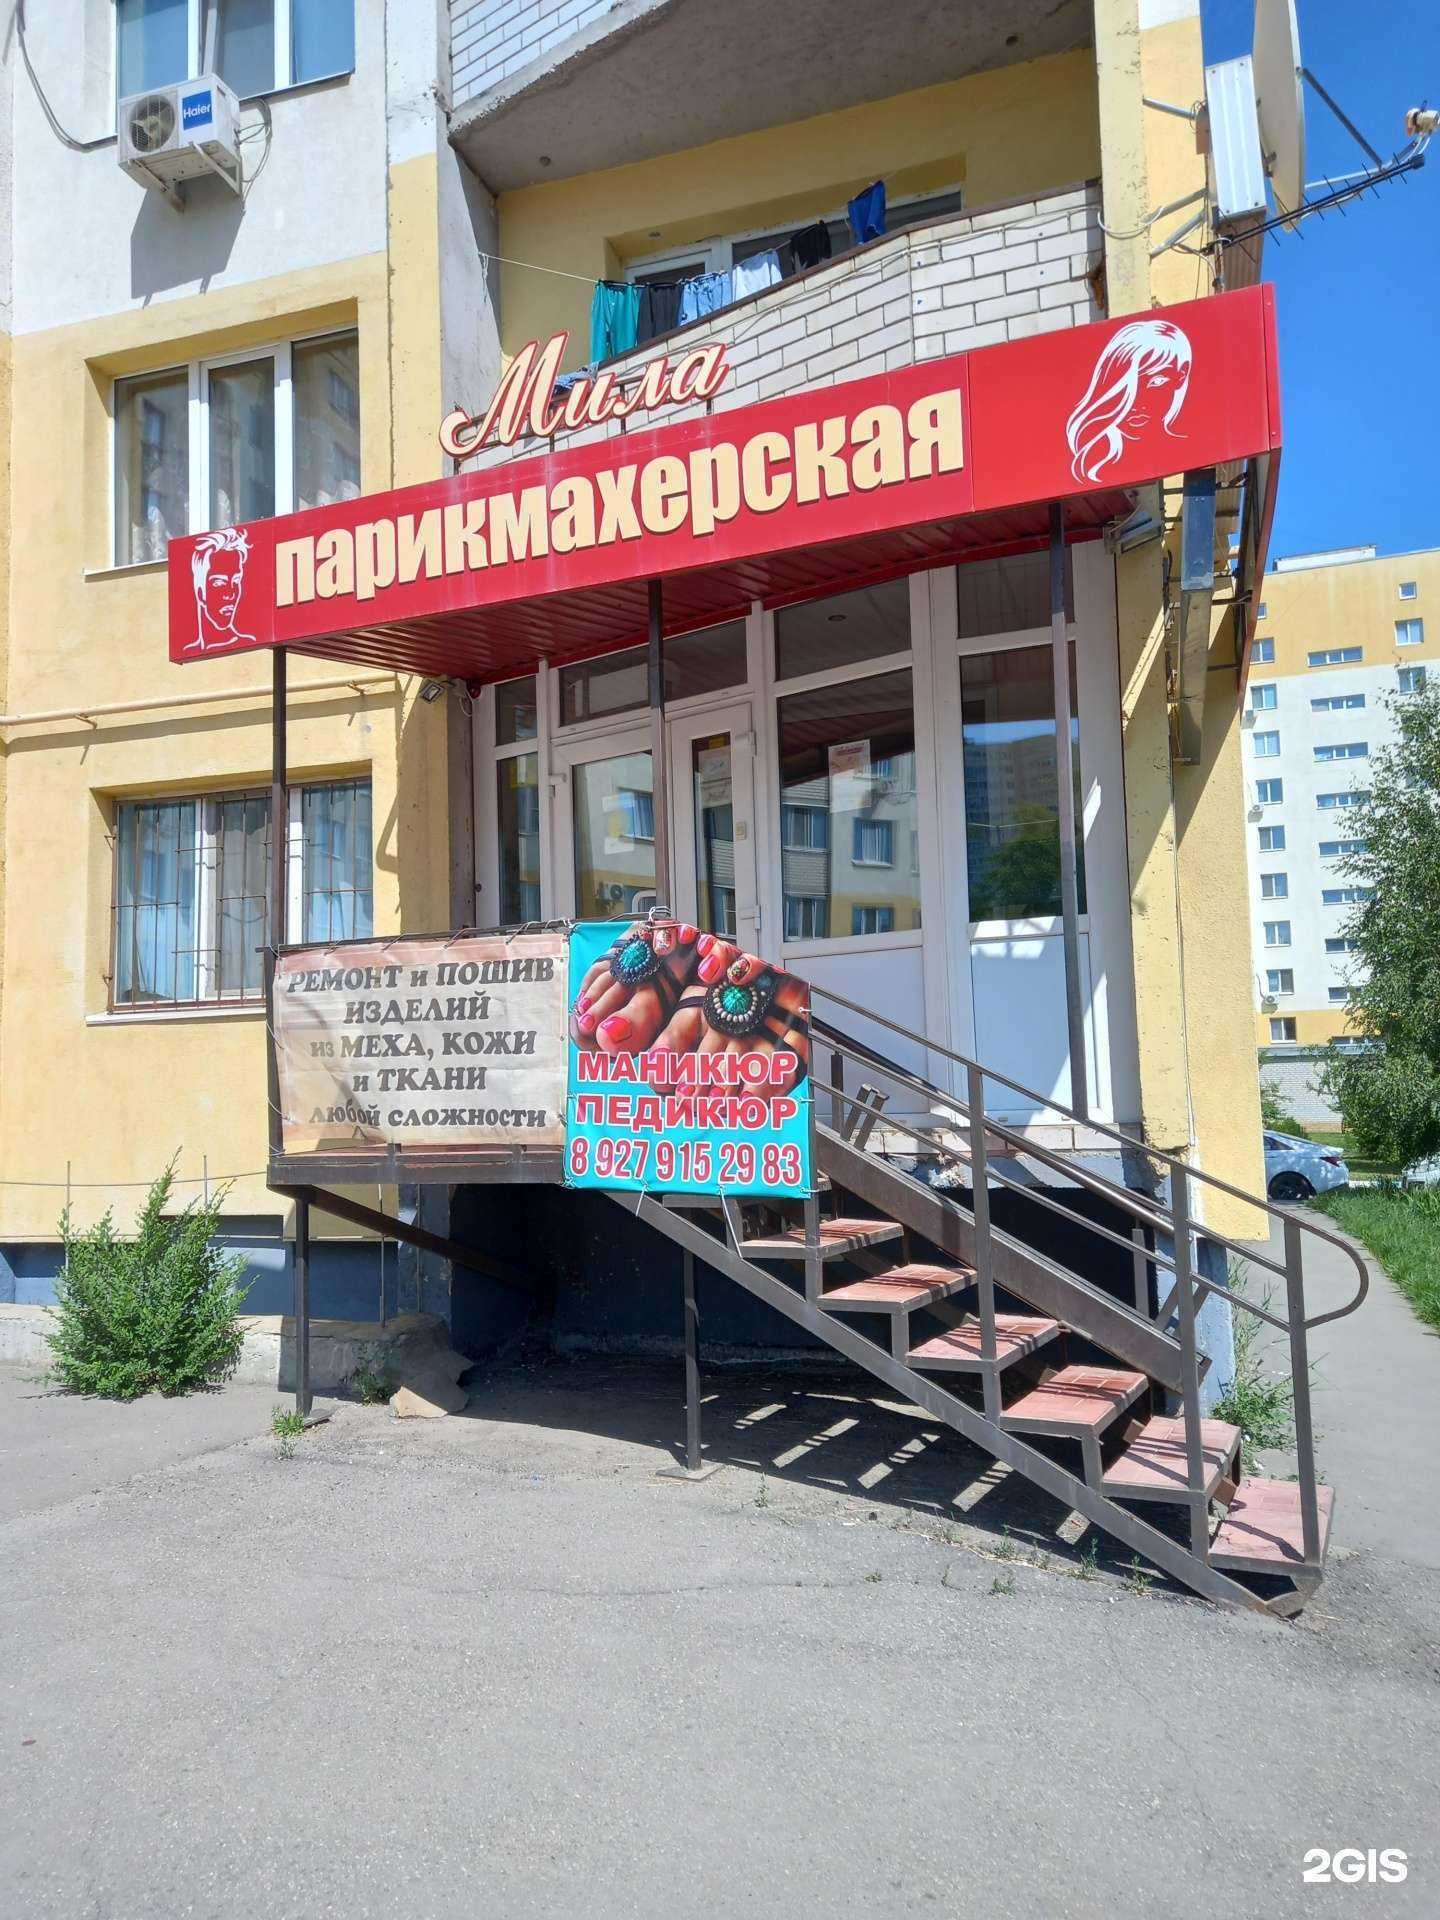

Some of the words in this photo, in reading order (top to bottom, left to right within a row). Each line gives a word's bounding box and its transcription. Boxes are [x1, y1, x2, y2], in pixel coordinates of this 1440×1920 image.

[183, 103, 211, 120] Haier
[439, 331, 731, 457] Мила
[275, 388, 965, 608] парикмахерская
[287, 964, 403, 993] РЕМОНТ
[410, 969, 427, 988] и
[435, 957, 554, 987] ПОШИВ
[342, 990, 491, 1026] ИЗДЕЛИЙ
[310, 1041, 334, 1059] из
[340, 1032, 434, 1060] МЕХА,
[442, 1030, 537, 1056] КОЖИ
[353, 1075, 369, 1092] и
[377, 1066, 487, 1092] ТКАНИ
[577, 1051, 798, 1085] МАНИКЮР
[576, 1094, 799, 1133] ПЕДИКЮР
[570, 1136, 590, 1176] 8
[595, 1138, 649, 1180] 927
[656, 1140, 712, 1184] 915
[719, 1142, 756, 1185] 29
[762, 1143, 802, 1187] 83
